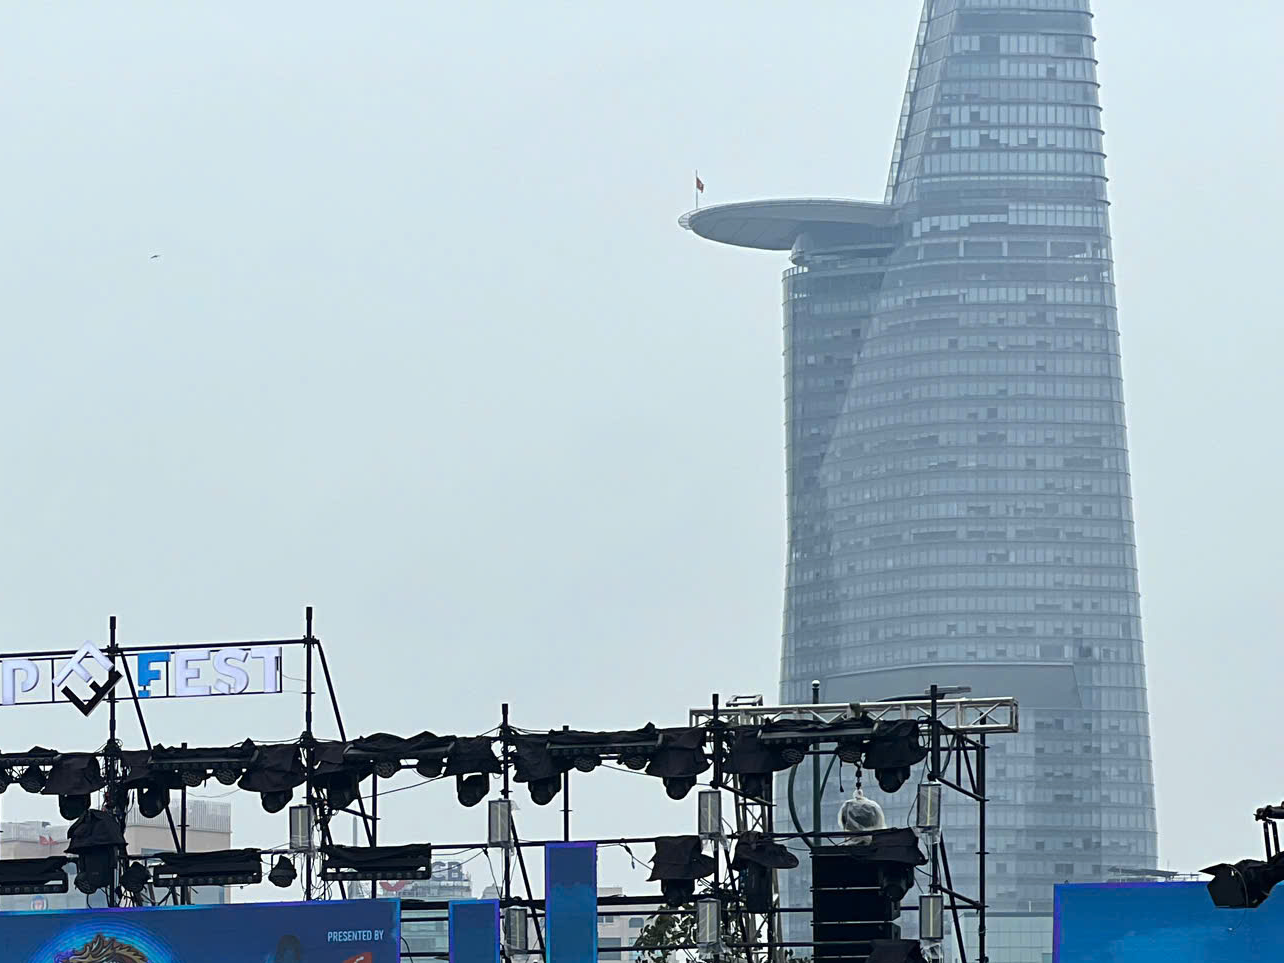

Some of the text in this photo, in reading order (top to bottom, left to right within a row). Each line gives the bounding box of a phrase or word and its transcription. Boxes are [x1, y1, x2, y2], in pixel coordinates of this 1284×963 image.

[137, 646, 282, 698] FEST
[327, 929, 384, 942] PRESENTED BY
